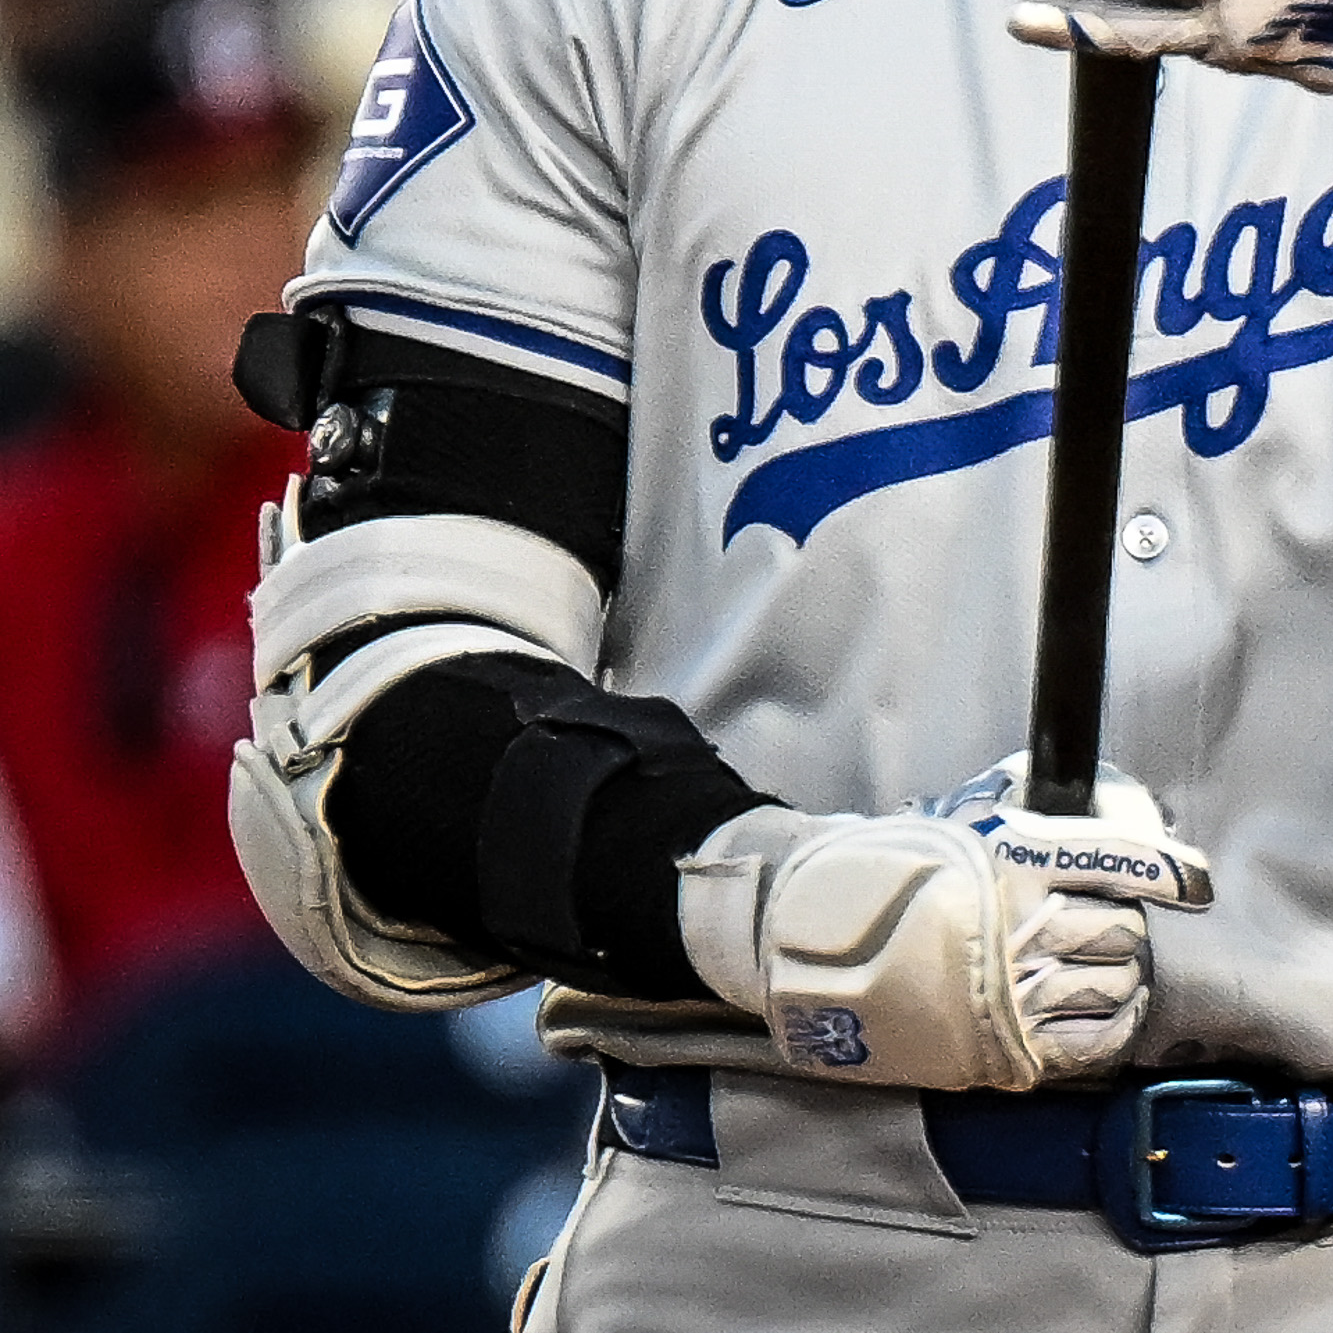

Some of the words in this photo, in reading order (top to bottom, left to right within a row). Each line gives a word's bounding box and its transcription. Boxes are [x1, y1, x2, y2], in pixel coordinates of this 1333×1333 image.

[700, 228, 925, 463] Los
[995, 840, 1051, 868] new
[1055, 846, 1160, 881] balance
